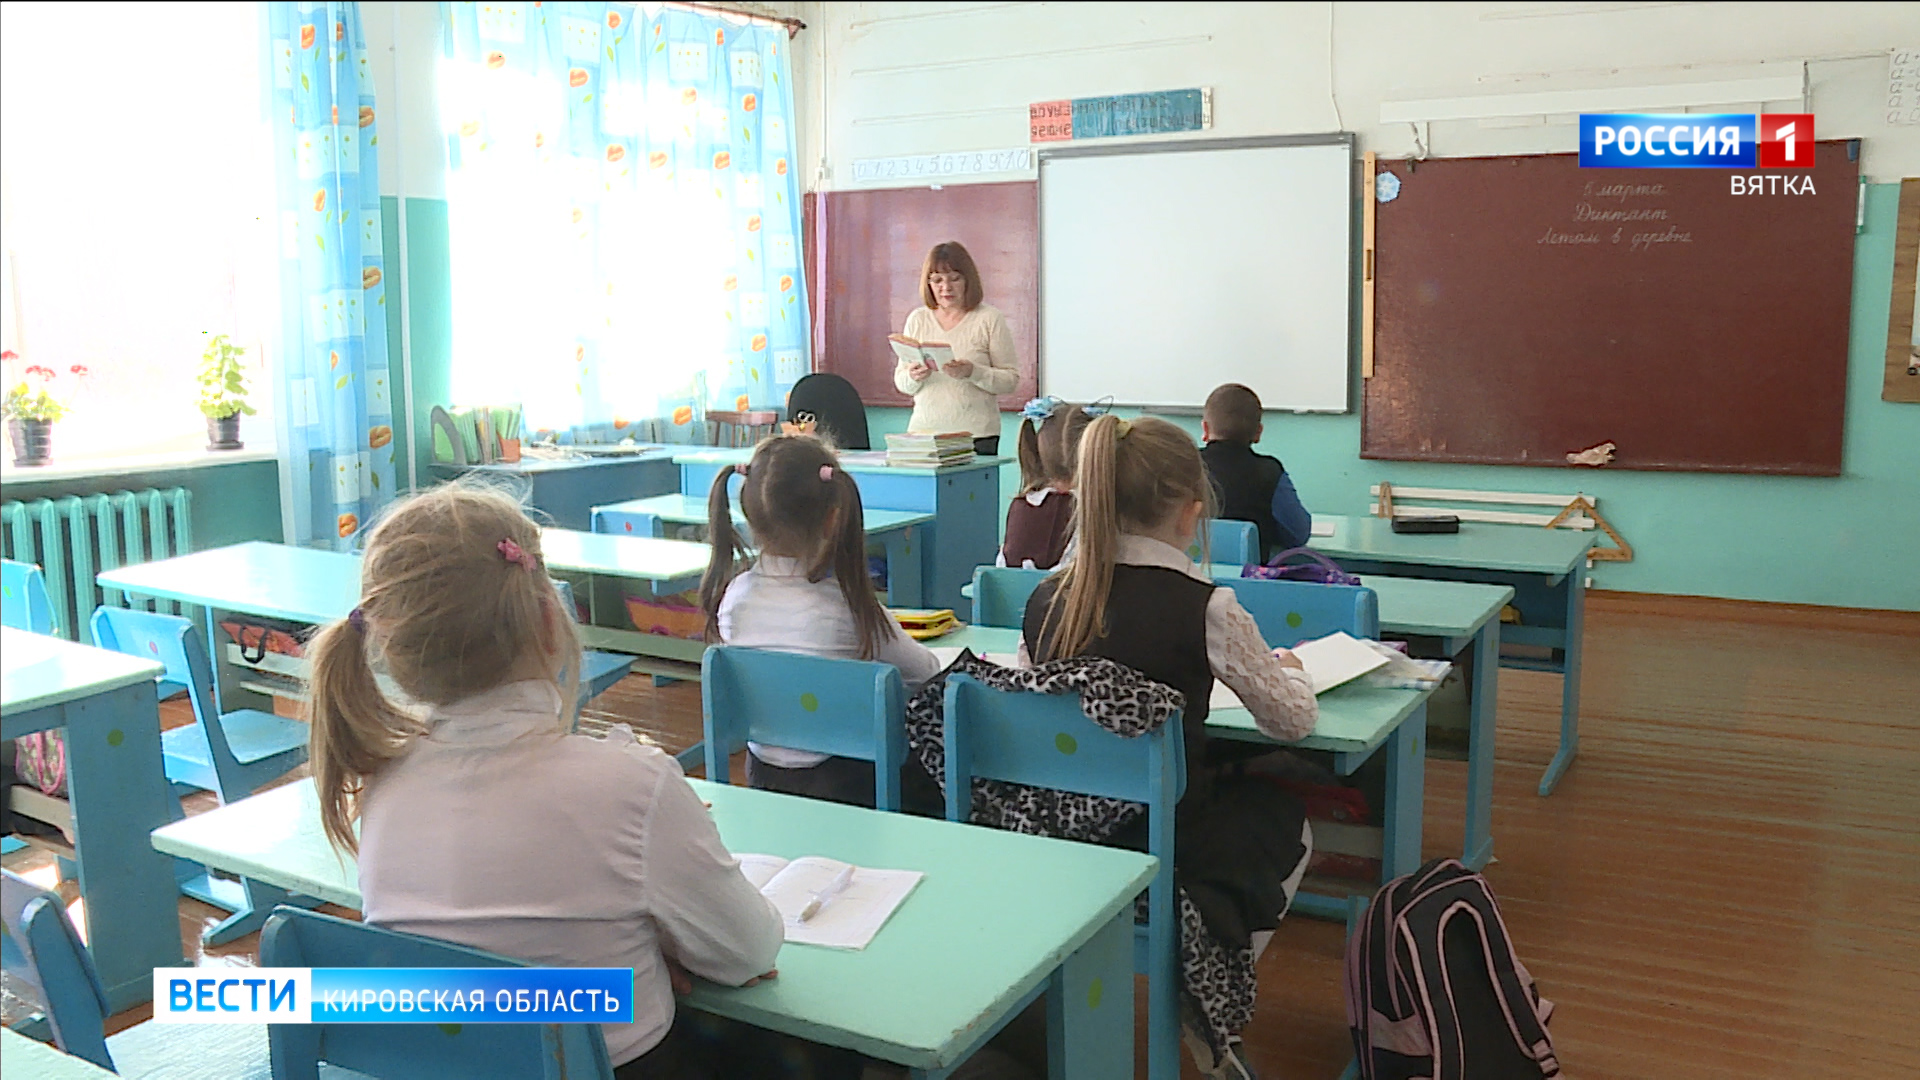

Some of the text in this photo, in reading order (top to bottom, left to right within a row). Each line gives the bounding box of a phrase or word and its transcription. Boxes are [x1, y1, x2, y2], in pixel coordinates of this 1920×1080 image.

[1597, 183, 1667, 203] марта
[1573, 202, 1668, 222] Диктант
[1537, 225, 1693, 251] Летом в деревне
